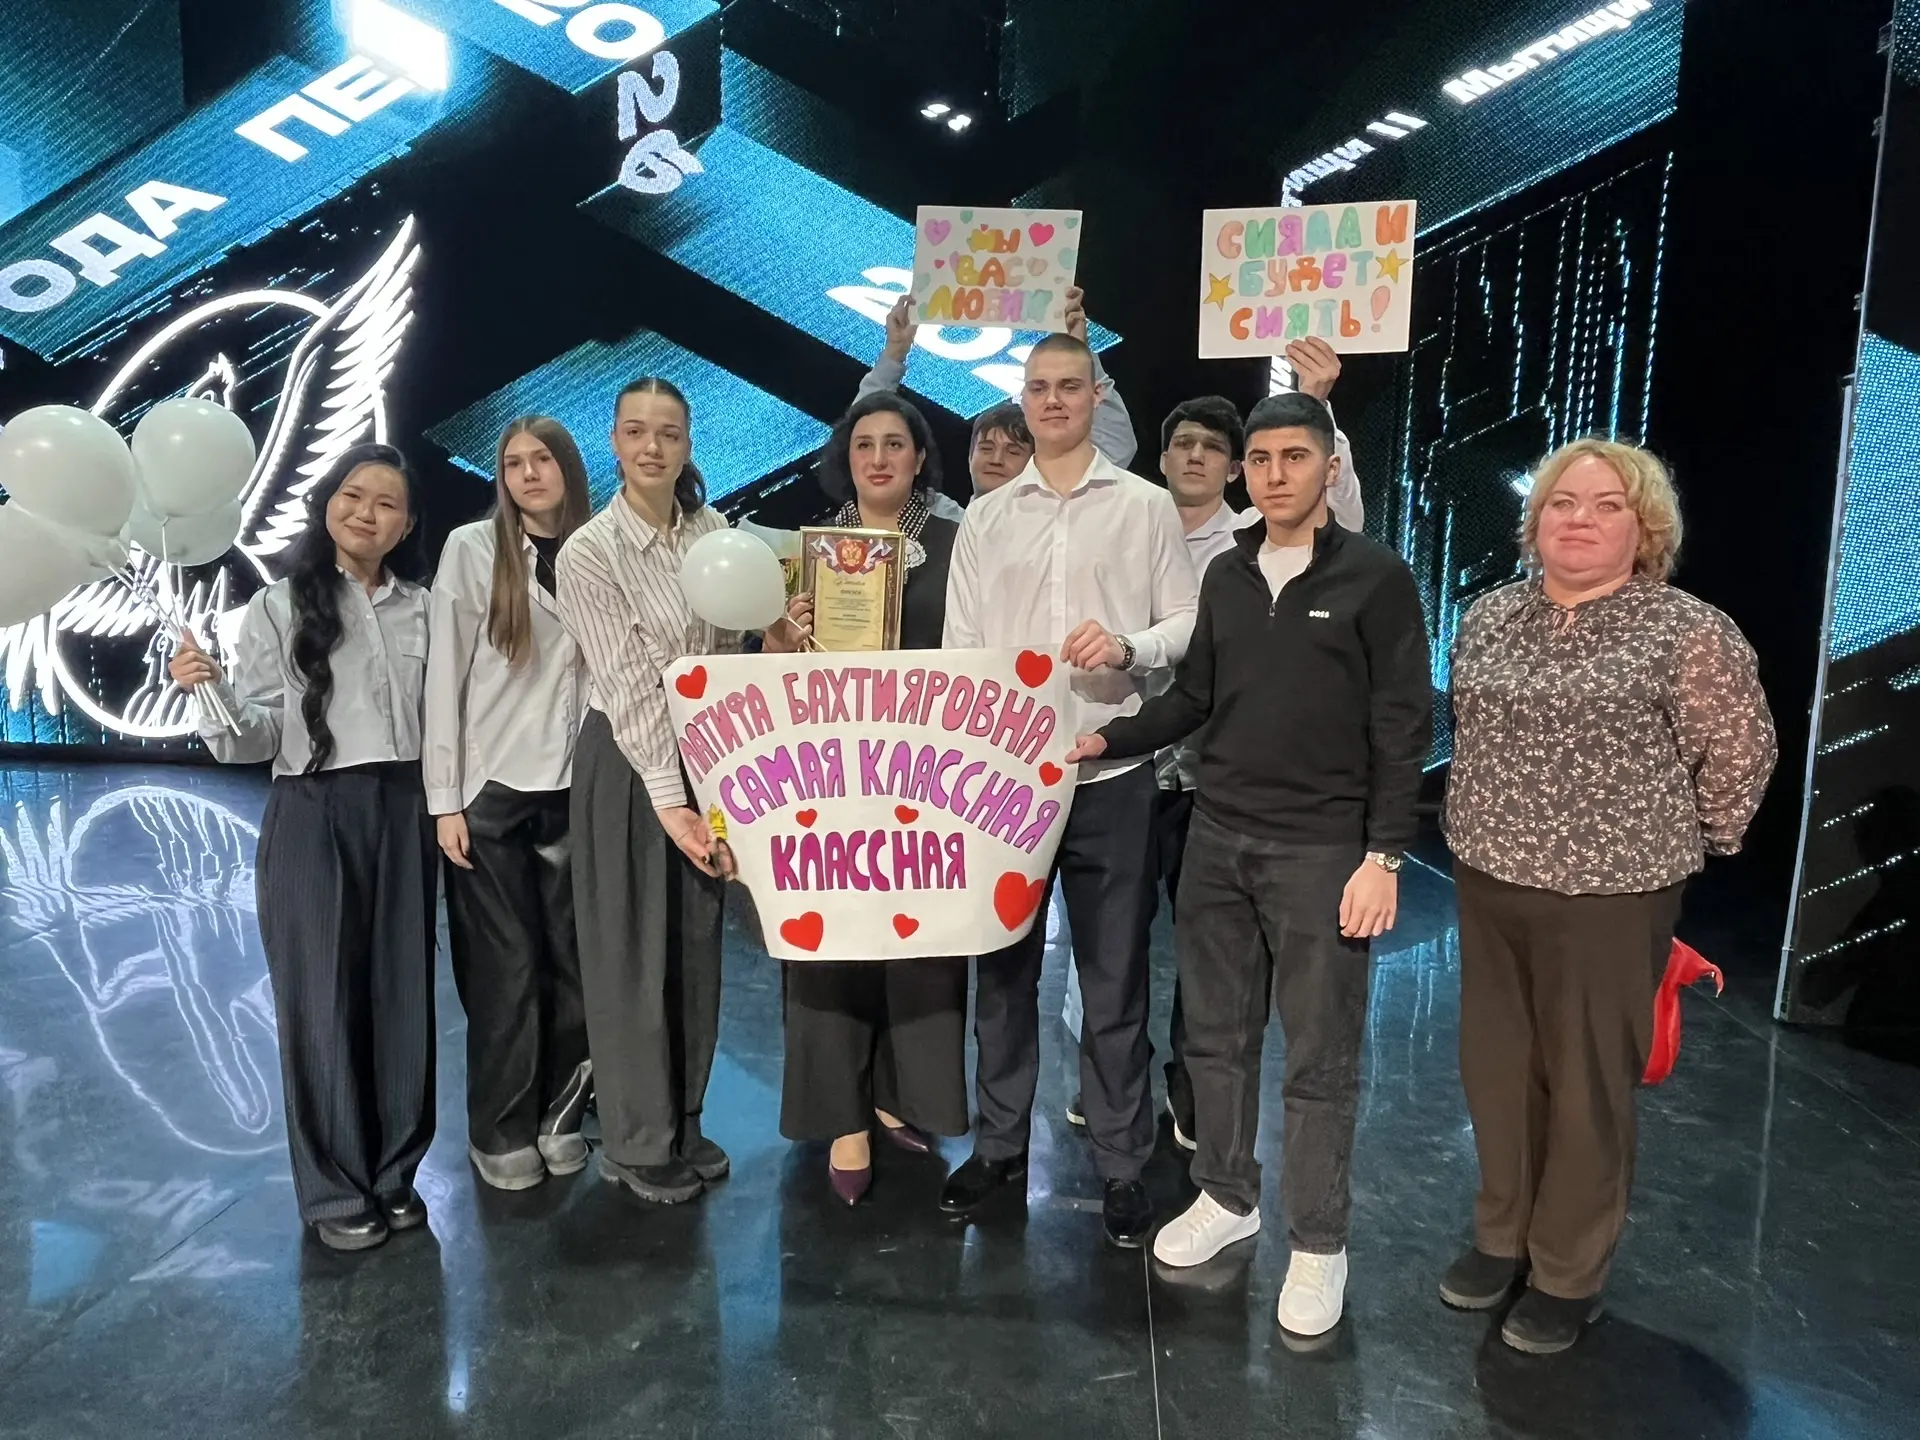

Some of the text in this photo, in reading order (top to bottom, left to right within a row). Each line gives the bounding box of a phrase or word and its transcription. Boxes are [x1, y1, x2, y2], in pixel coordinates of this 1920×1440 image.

[1216, 204, 1408, 259] СИЯЛА И
[956, 254, 1025, 288] ВАС
[1238, 251, 1374, 298] БУДЕТ
[679, 668, 1056, 784] ЛАТИФА БАХТИЯРОВНА
[719, 738, 1060, 854] САМАЯ КЛАССНАЯ
[770, 830, 967, 892] КЛАССНАЯ
